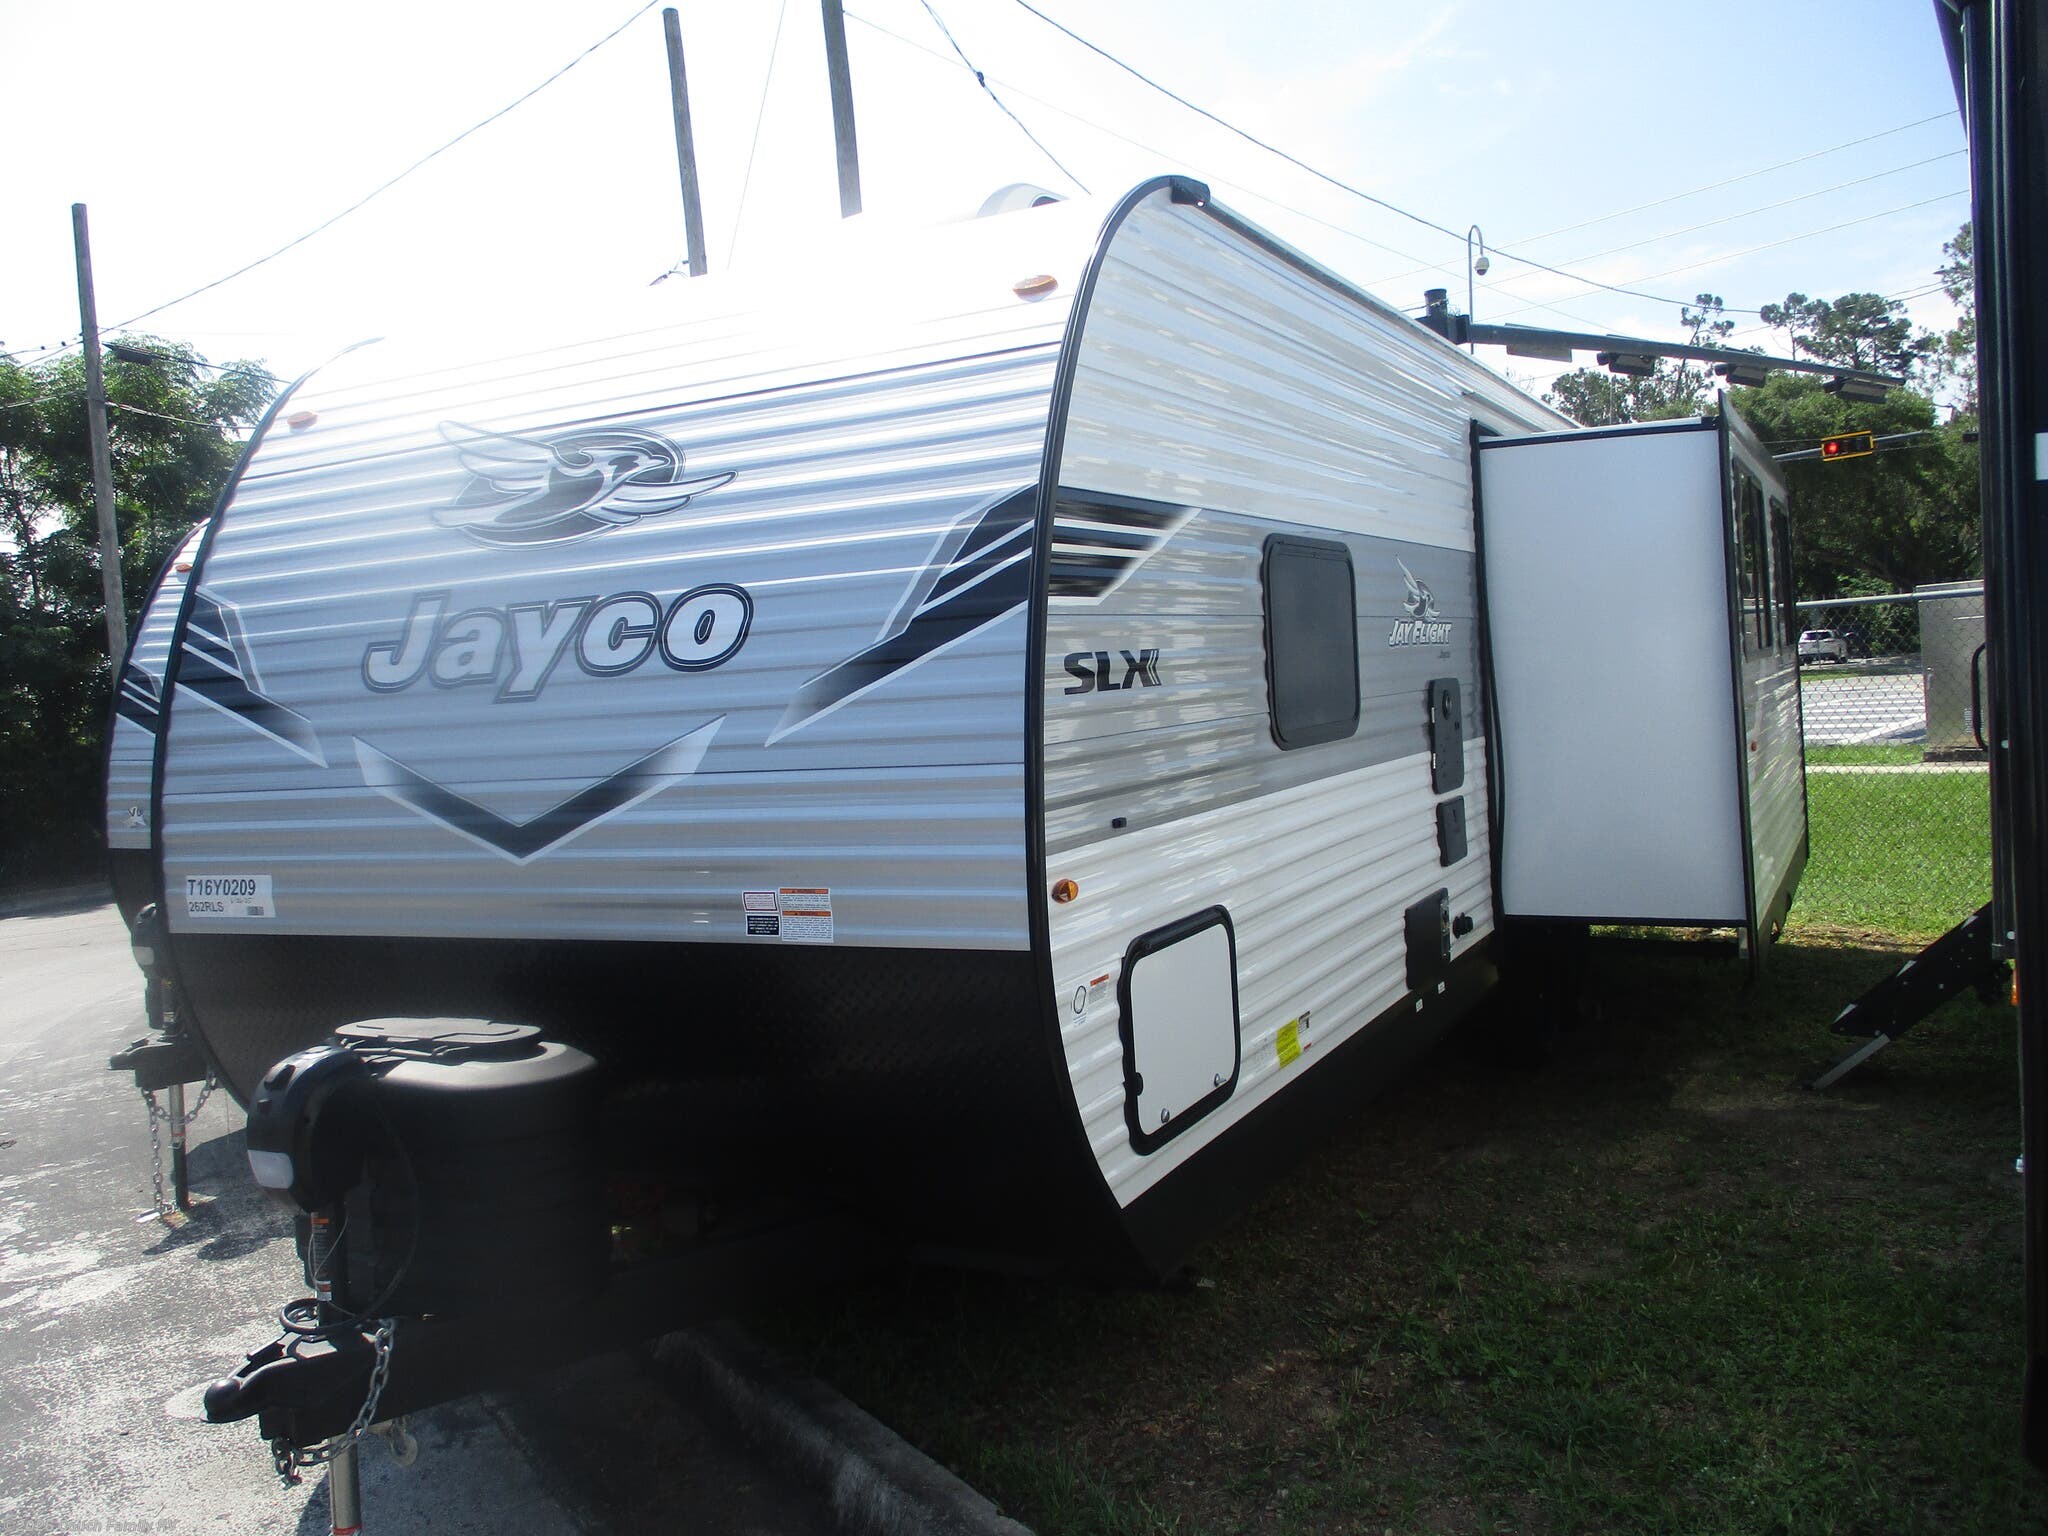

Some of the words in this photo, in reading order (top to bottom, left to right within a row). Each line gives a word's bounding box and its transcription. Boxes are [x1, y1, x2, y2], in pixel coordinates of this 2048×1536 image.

[362, 583, 753, 703] Jayco
[1389, 619, 1413, 647] JAY
[1412, 620, 1452, 645] FLIGHT
[1064, 648, 1161, 695] SLX
[187, 879, 256, 896] T16Y0209
